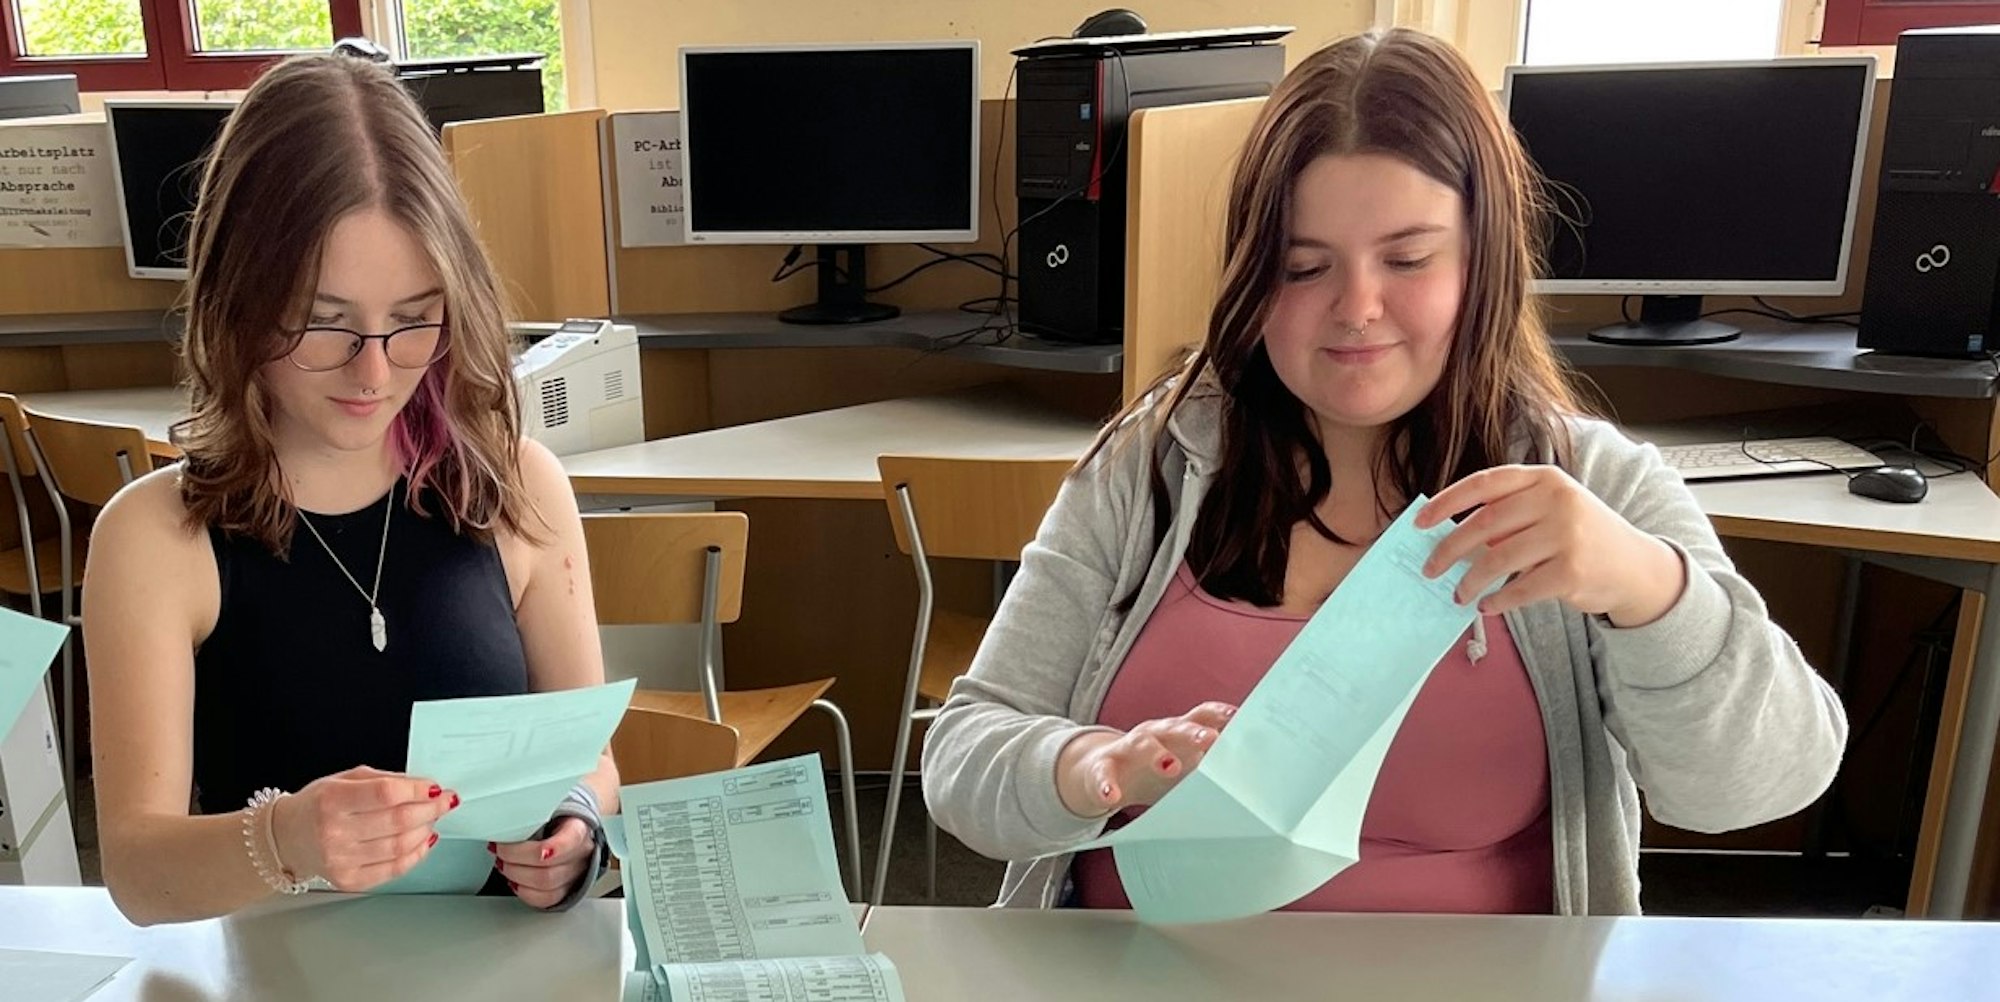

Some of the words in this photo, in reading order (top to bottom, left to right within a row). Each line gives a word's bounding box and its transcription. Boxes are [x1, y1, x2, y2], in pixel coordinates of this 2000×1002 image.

[18, 166, 42, 175] nur
[52, 164, 85, 175] nach
[649, 158, 672, 170] ist
[0, 180, 75, 194] Absprache
